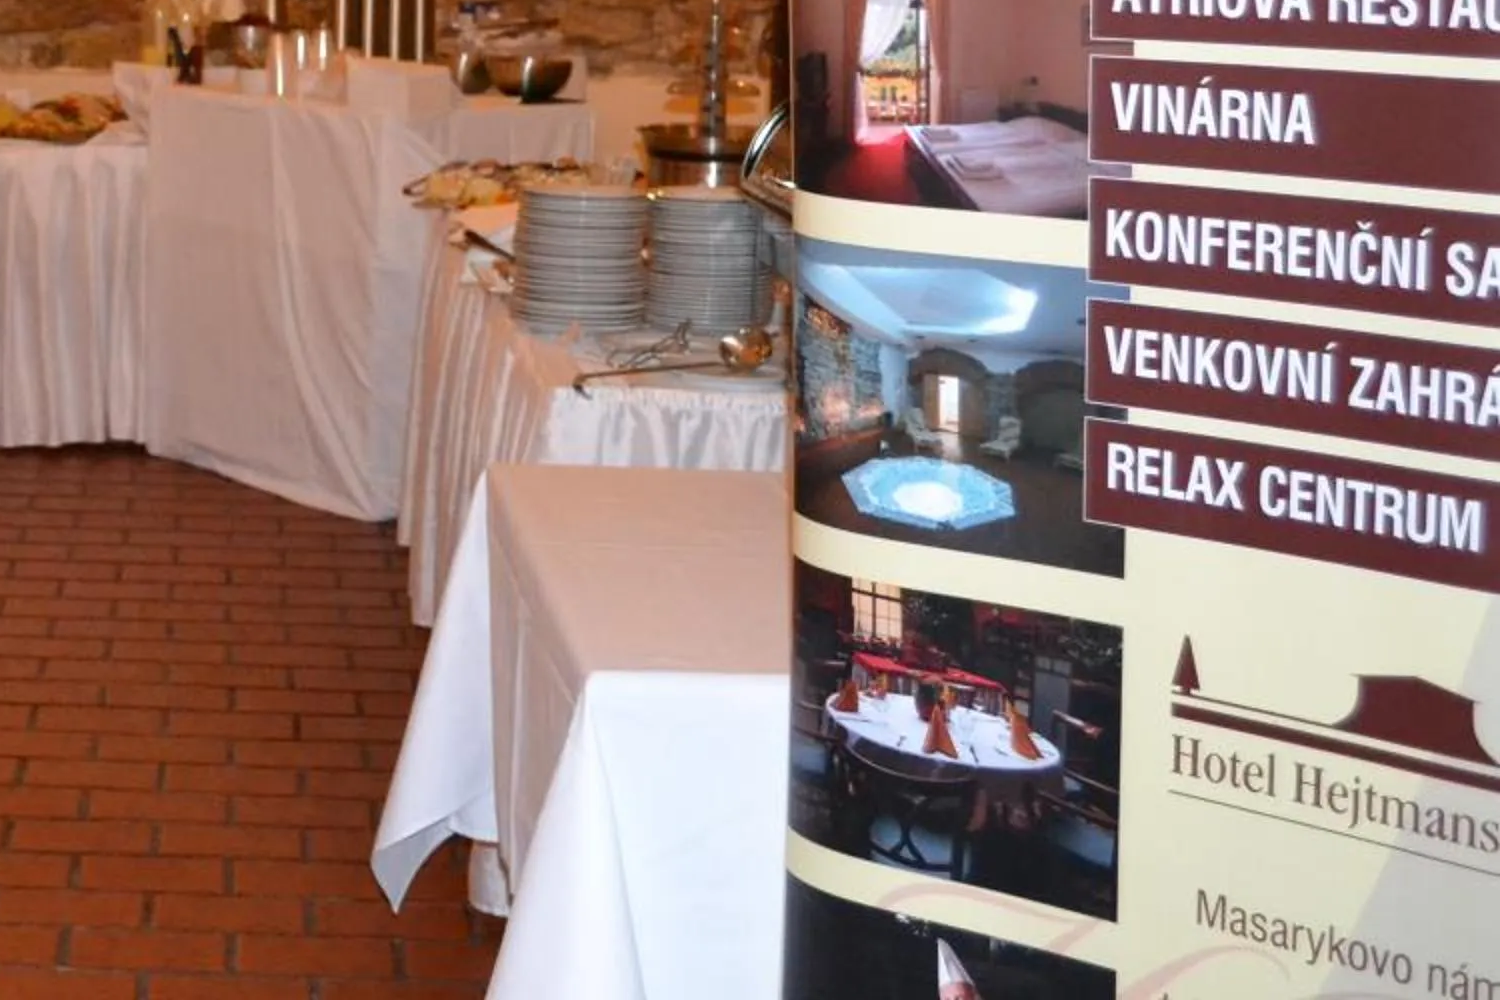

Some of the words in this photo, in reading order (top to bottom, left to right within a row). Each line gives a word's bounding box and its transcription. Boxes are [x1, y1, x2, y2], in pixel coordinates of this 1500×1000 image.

[1111, 76, 1317, 146] VINÁRNA
[1105, 207, 1434, 292] KONFERENČNÍ
[1104, 325, 1339, 404] VENKOVNÍ
[1106, 441, 1245, 512] RELAX
[1259, 464, 1484, 553] CENTRUM
[1171, 733, 1276, 798] Hotel
[1294, 760, 1500, 853] Hejtmans
[1196, 887, 1413, 985] Masarykovo
